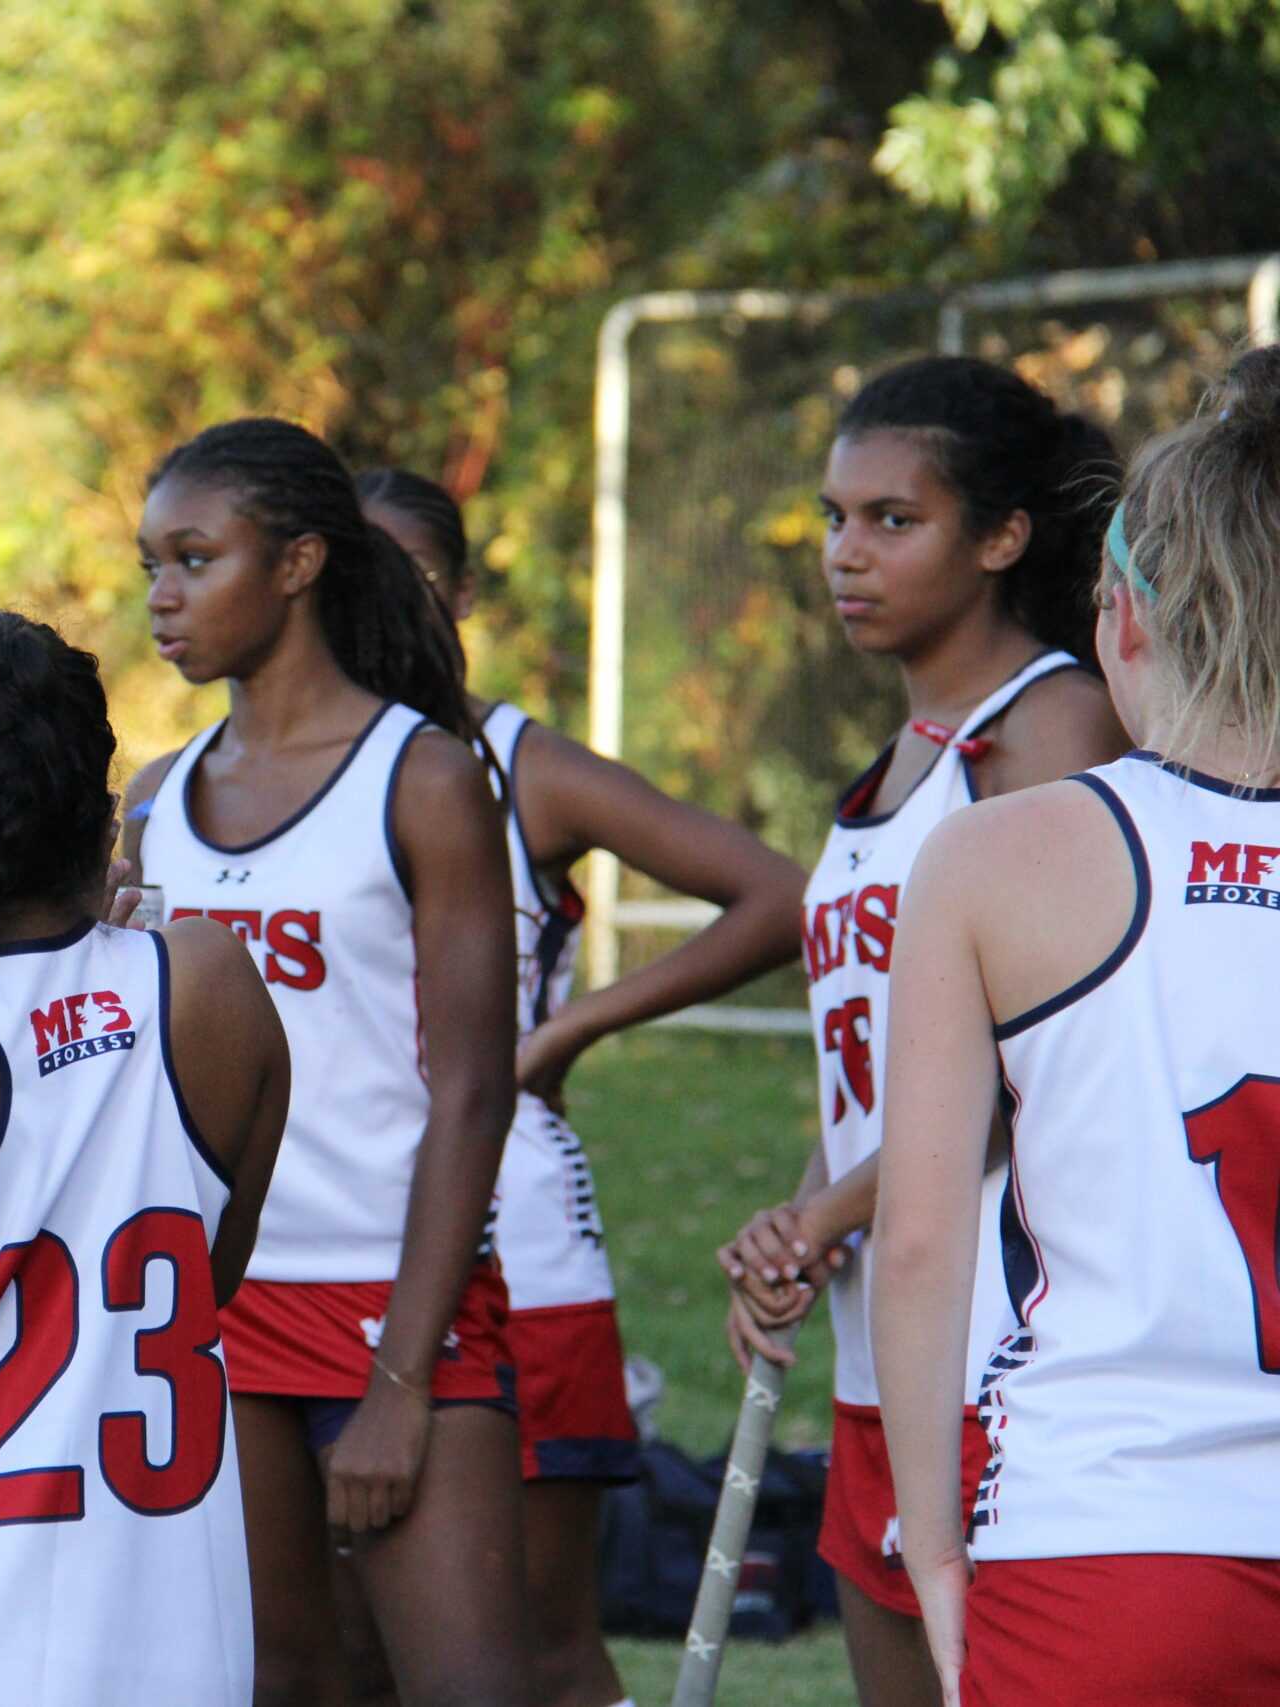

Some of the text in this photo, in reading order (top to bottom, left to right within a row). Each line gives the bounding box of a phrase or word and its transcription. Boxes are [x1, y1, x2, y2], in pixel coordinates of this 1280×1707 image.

[1187, 841, 1280, 885] MF
[1206, 886, 1280, 908] FOXE
[30, 990, 132, 1057] MFS
[52, 1035, 122, 1068] FOXES
